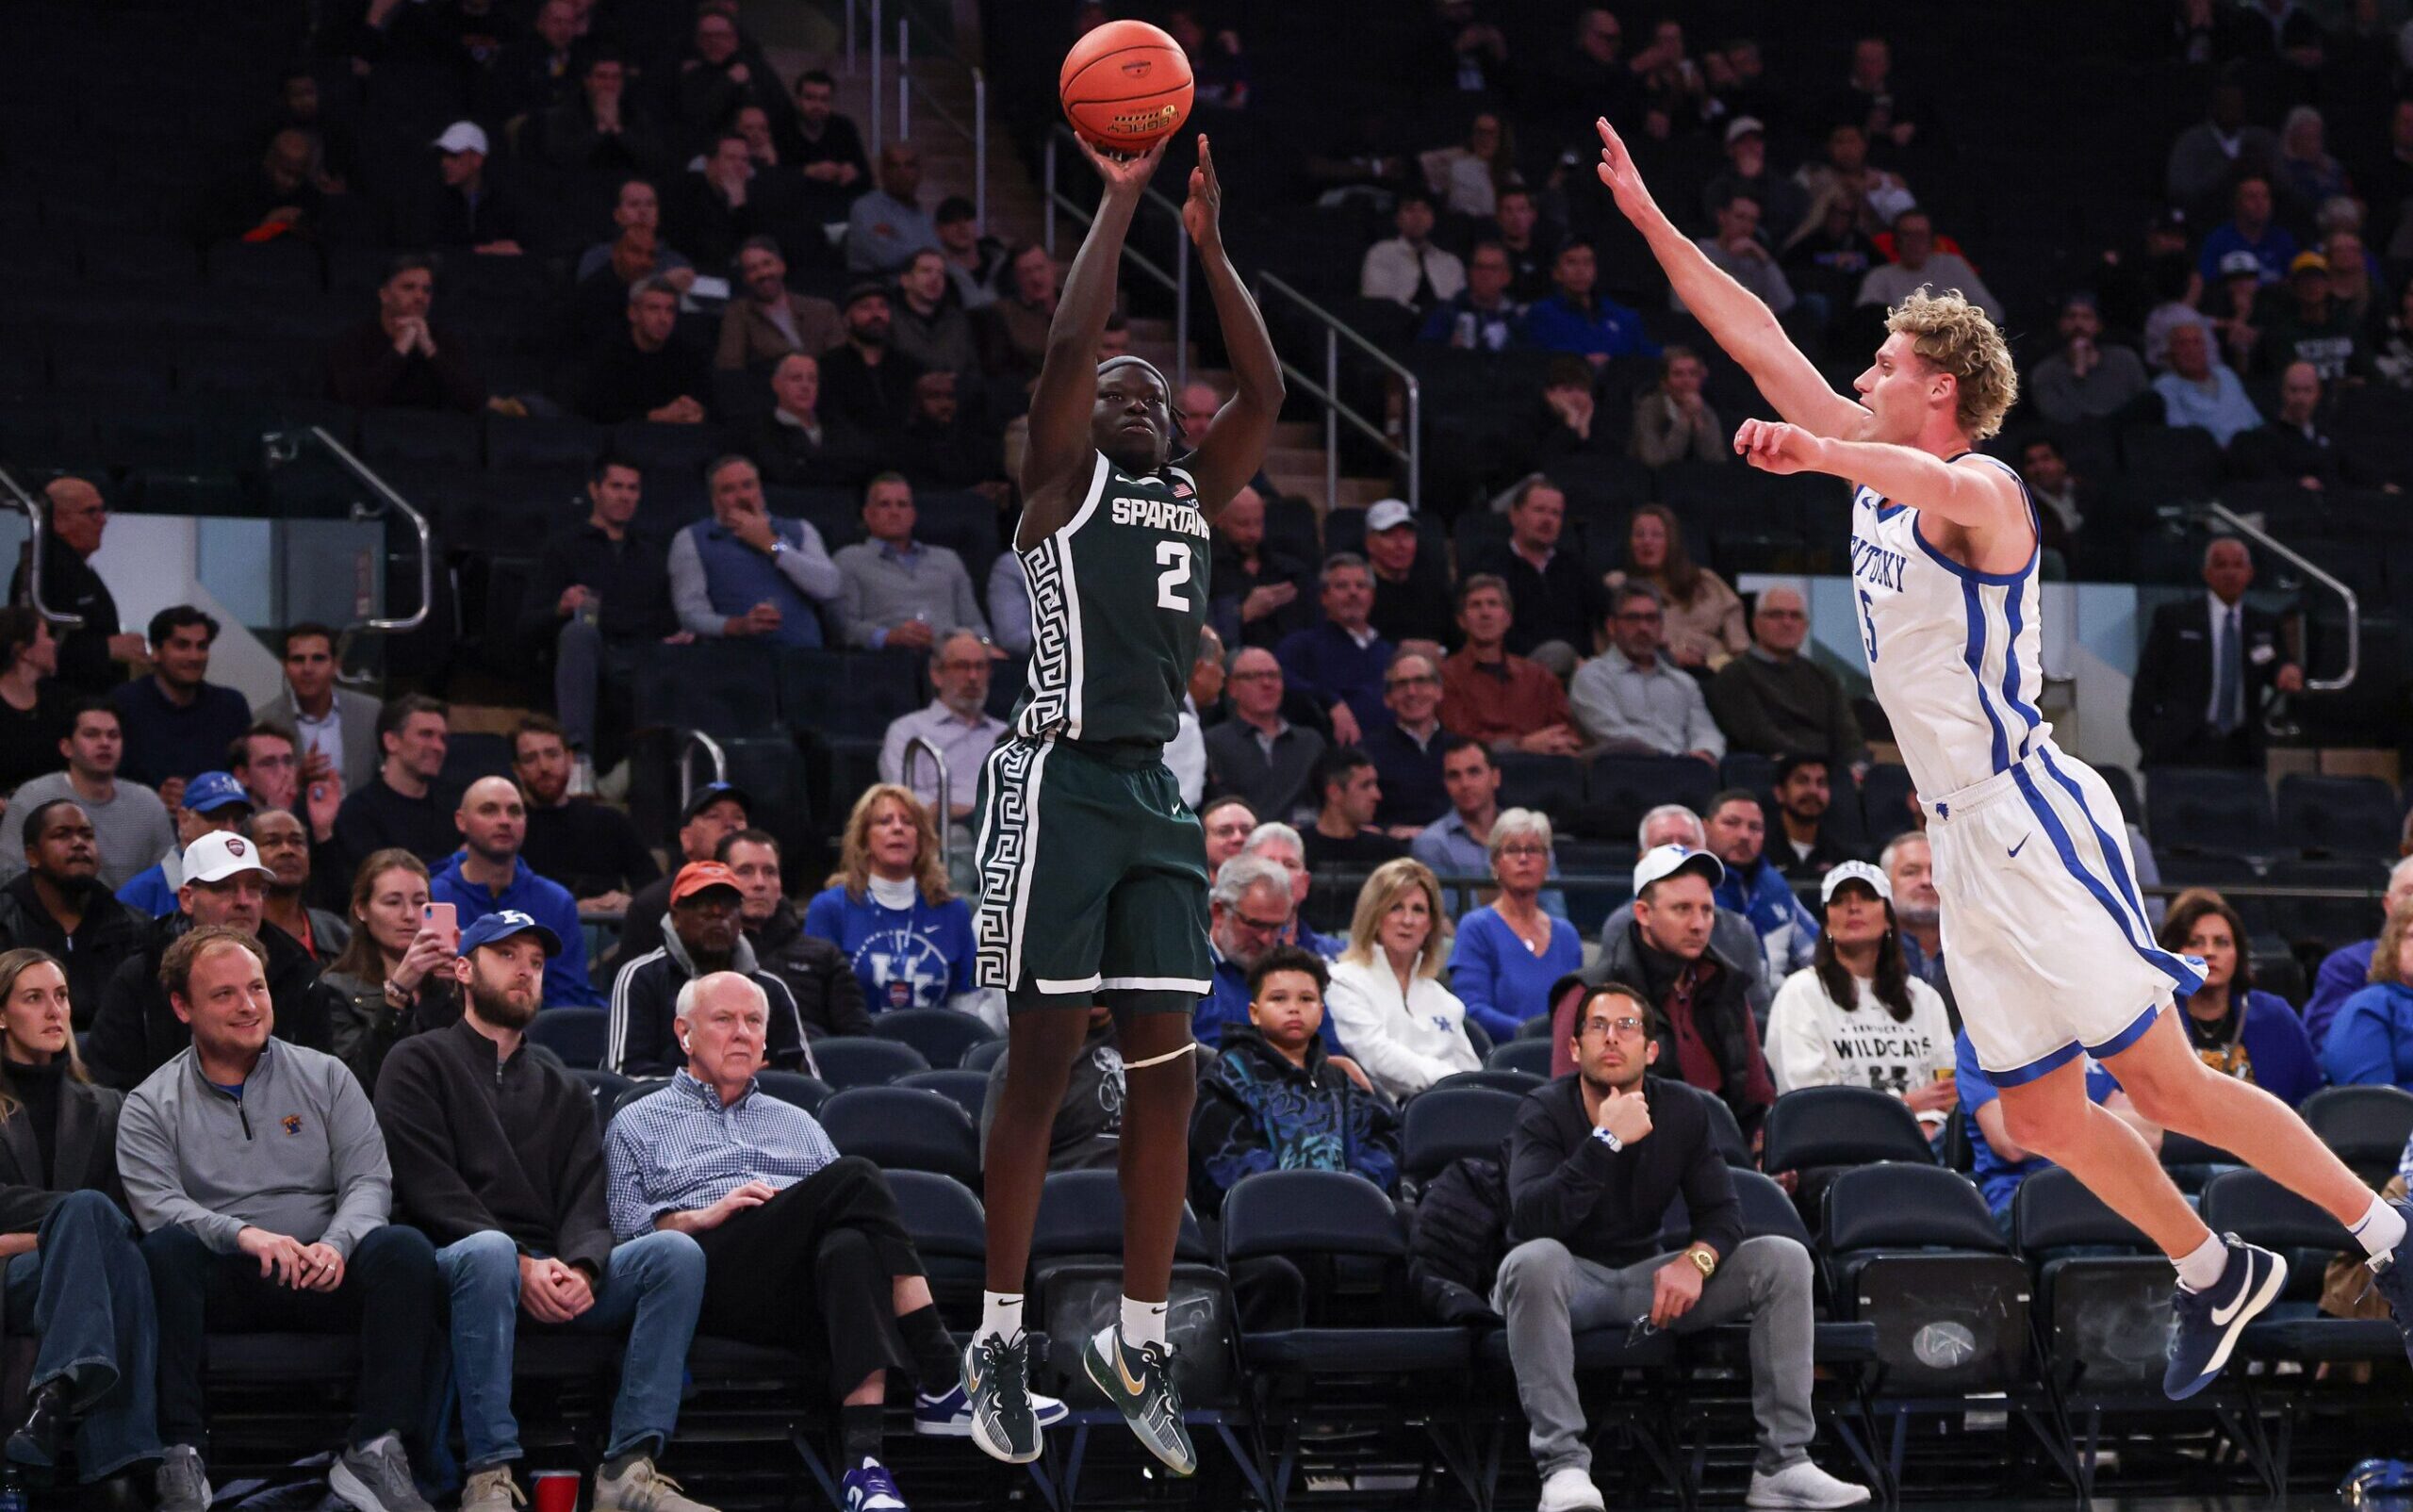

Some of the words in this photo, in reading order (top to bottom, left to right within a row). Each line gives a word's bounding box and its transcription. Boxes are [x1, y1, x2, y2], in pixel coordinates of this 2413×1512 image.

[1156, 540, 1191, 612] 2
[1860, 588, 1878, 663] 5
[1833, 1036, 1931, 1060] WILDCATS
